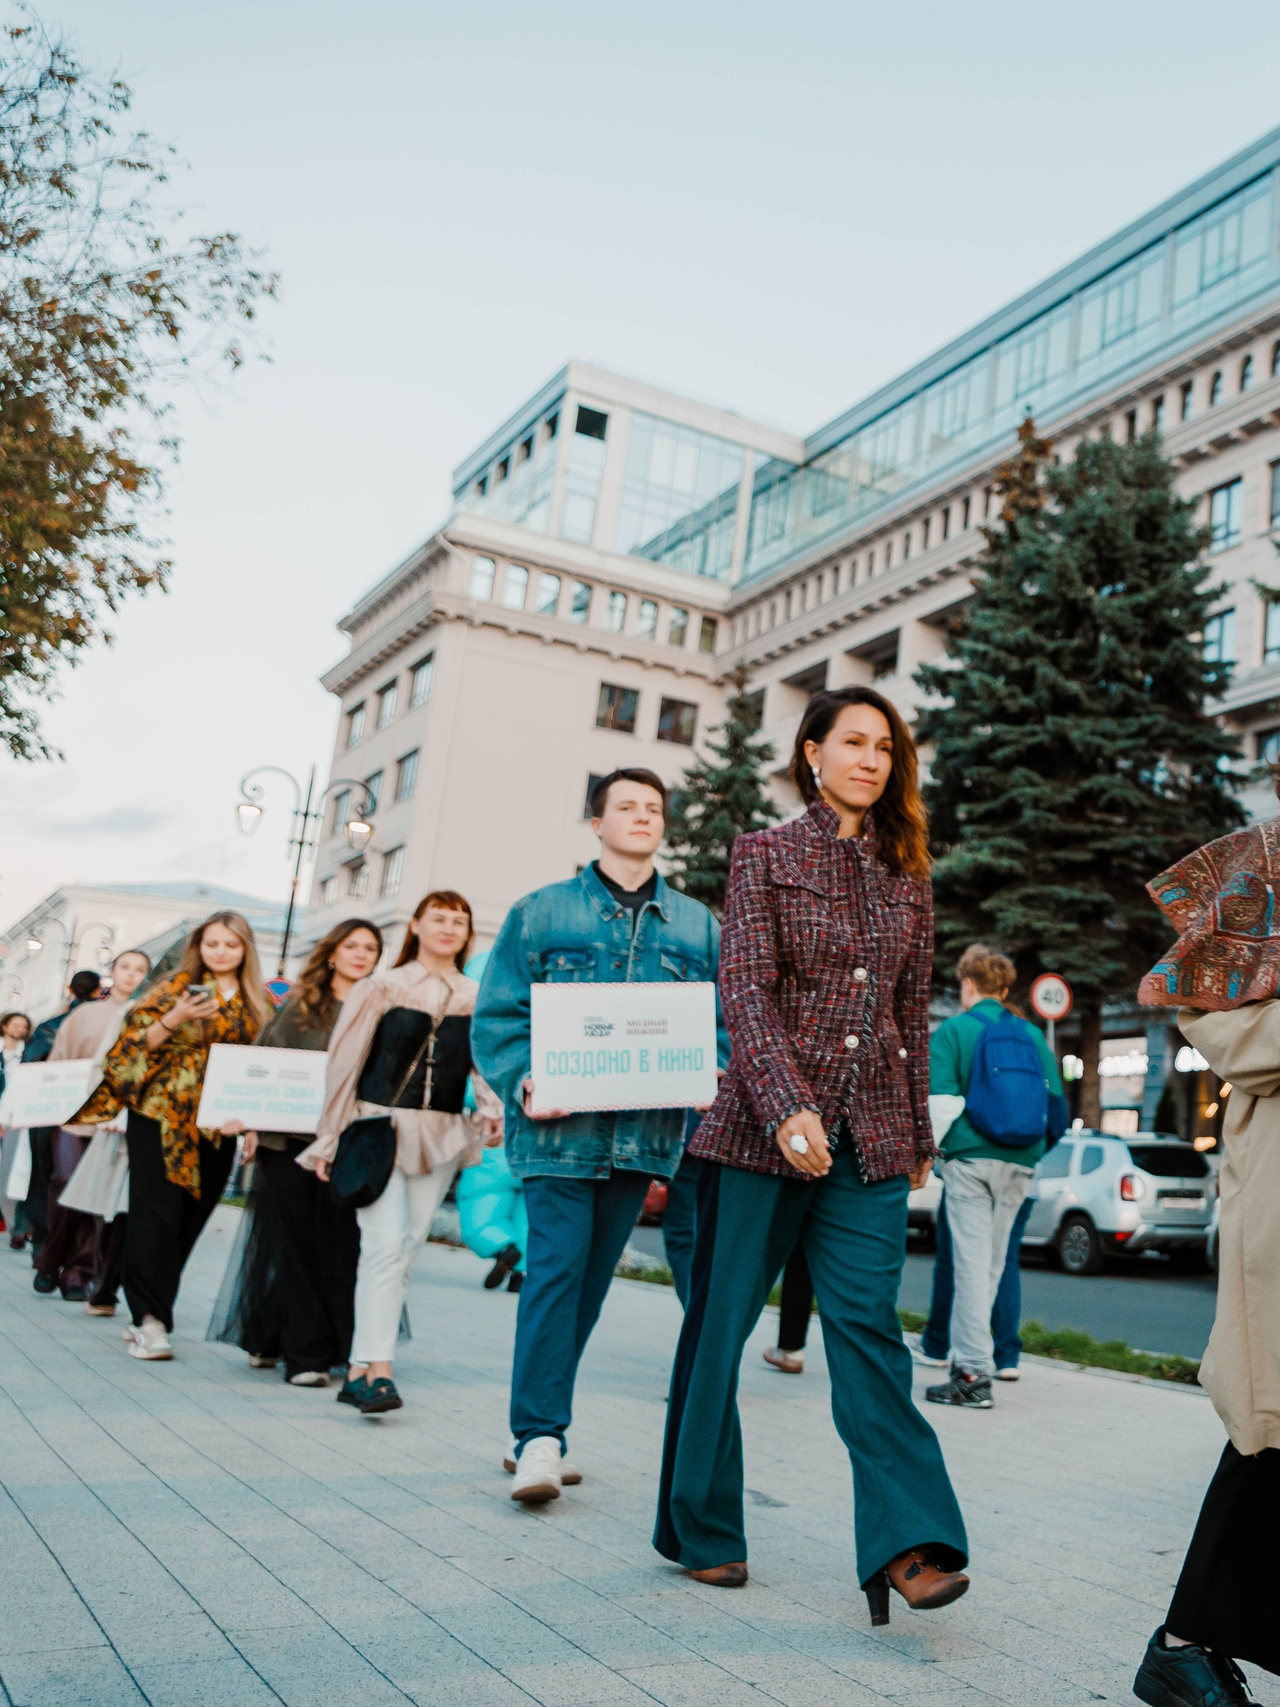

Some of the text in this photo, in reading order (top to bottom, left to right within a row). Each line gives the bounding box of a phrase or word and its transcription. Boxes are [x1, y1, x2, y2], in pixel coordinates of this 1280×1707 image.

[1042, 988, 1064, 1004] 40
[546, 1047, 704, 1079] СОЗДАНО В НИНО
